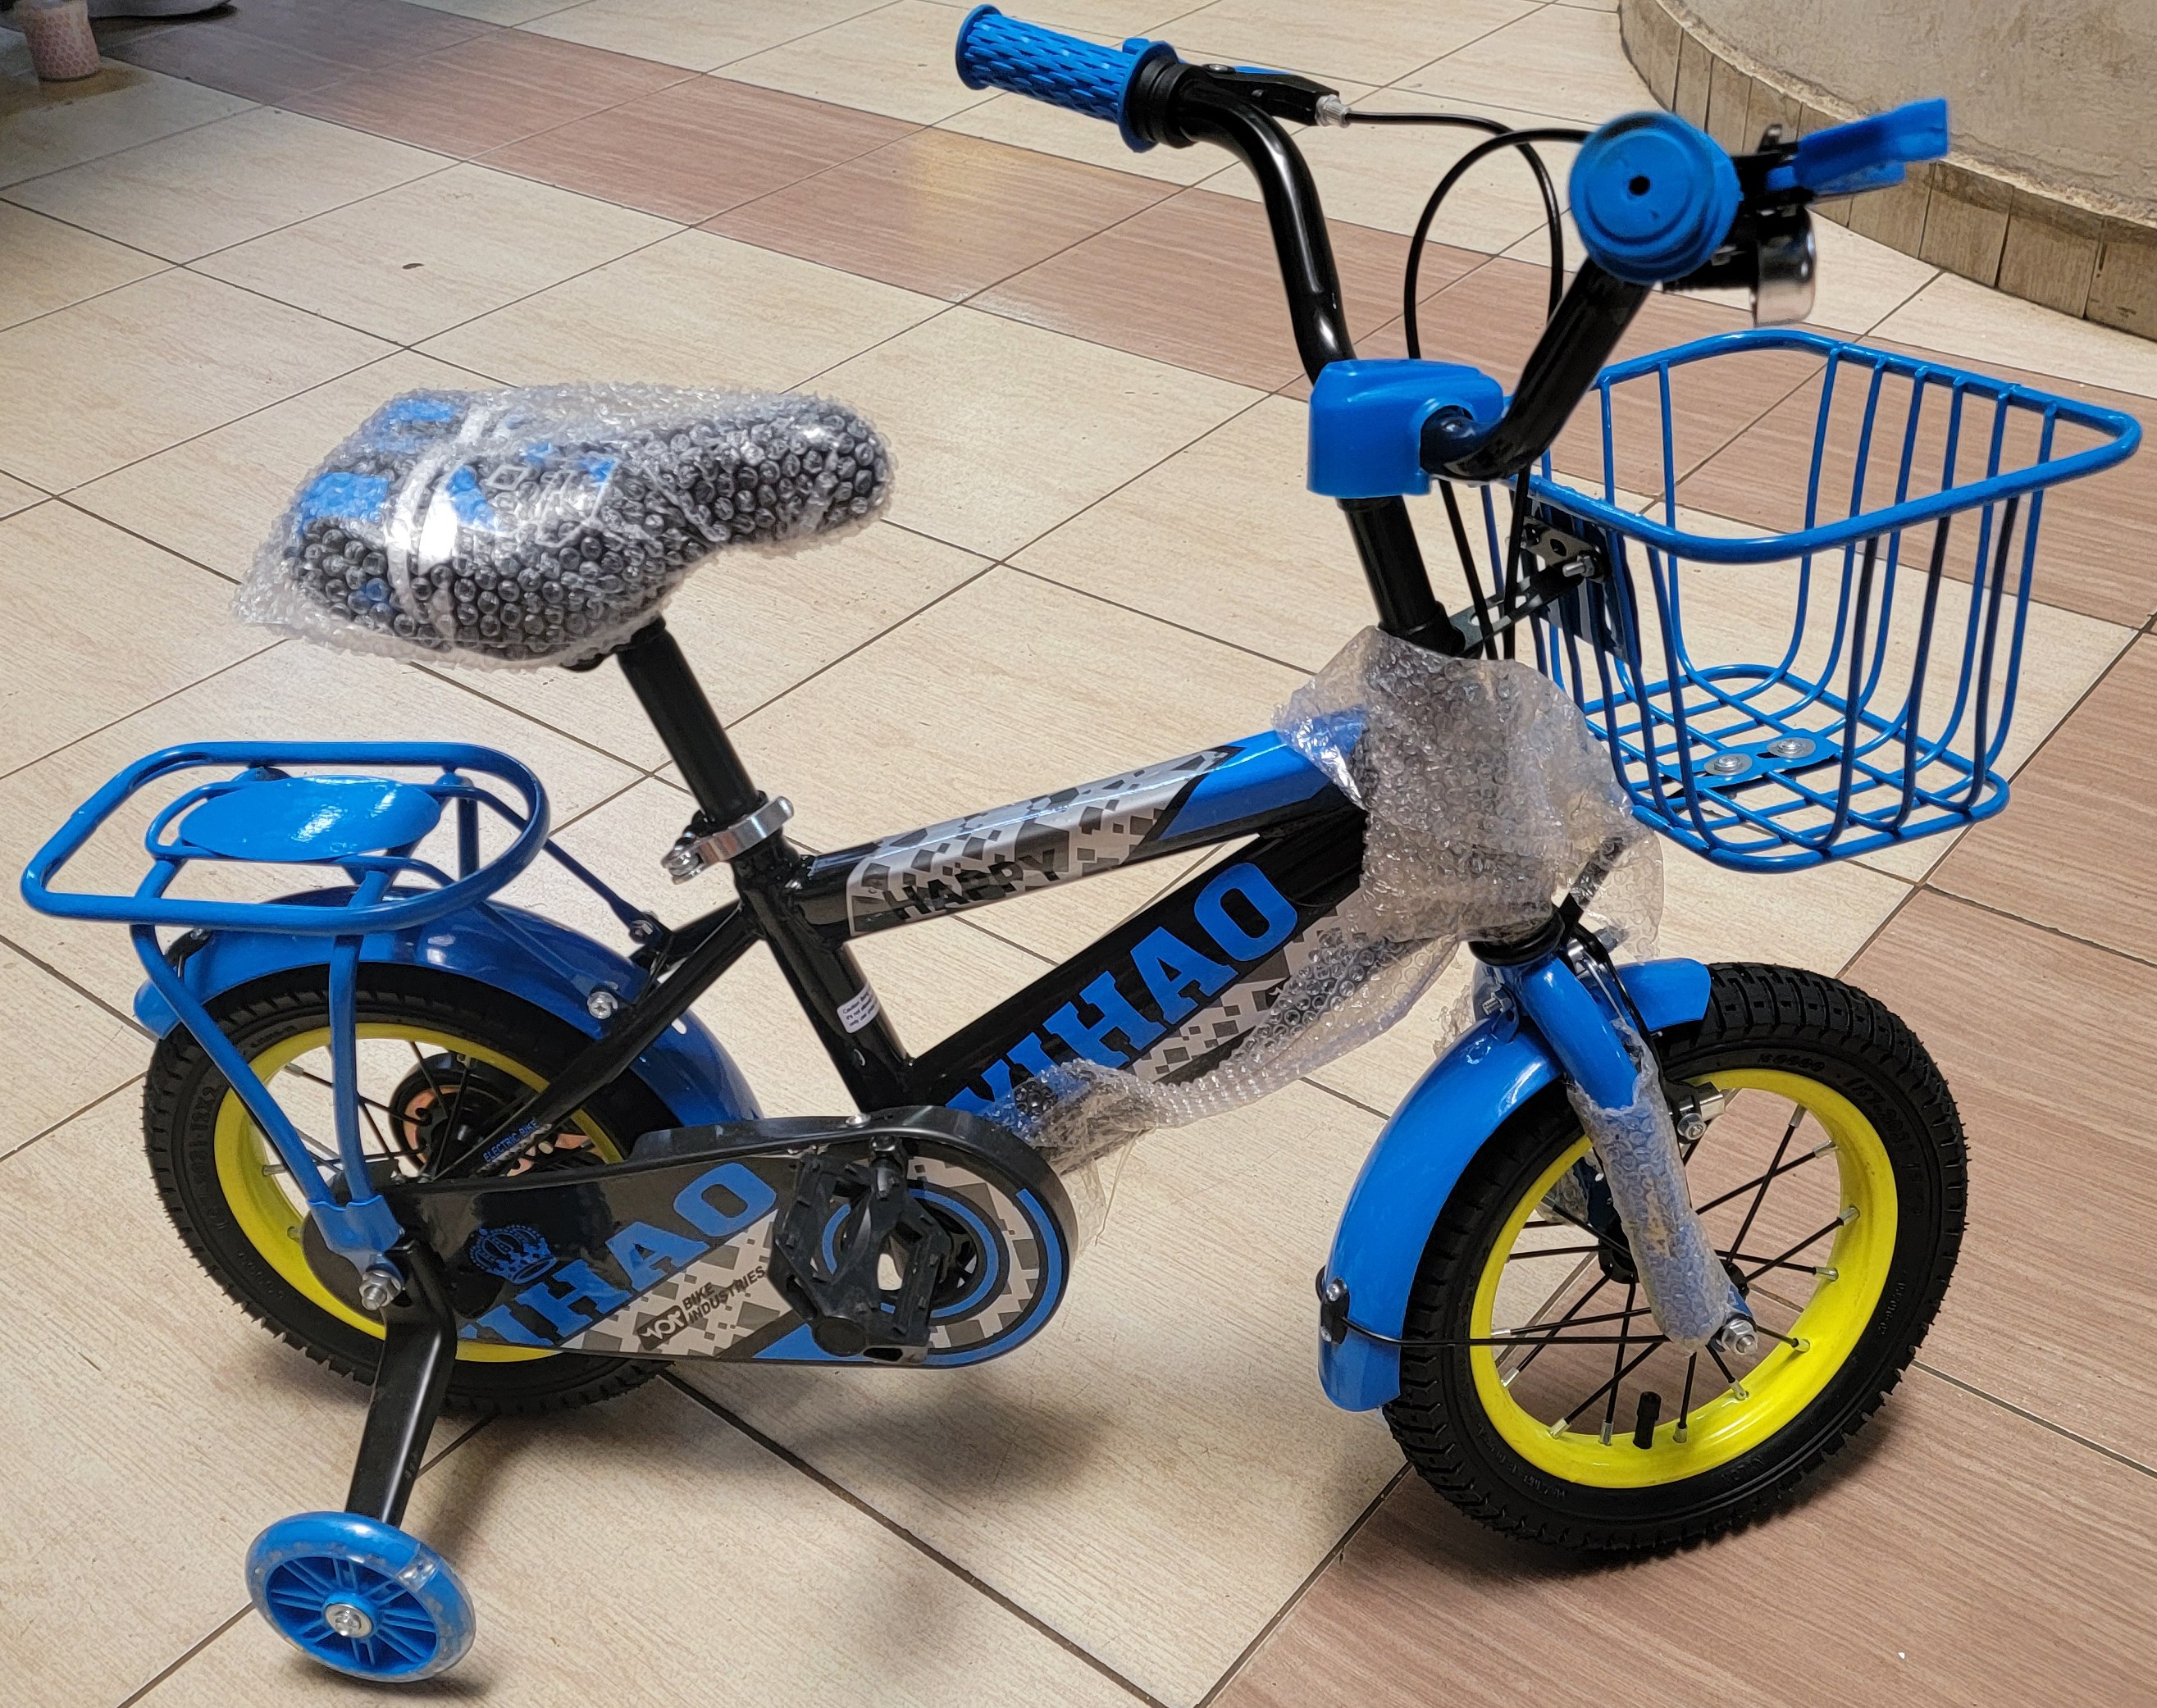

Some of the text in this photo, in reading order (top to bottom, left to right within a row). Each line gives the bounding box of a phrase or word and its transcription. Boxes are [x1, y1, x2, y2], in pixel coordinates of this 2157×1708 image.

[882, 849, 1060, 919] HAPPY
[482, 1117, 540, 1163] ELECTRIC BIKE
[459, 1162, 778, 1346] IHAO
[682, 1281, 716, 1311] BIKE
[685, 1265, 766, 1323] INDUSTRIES
